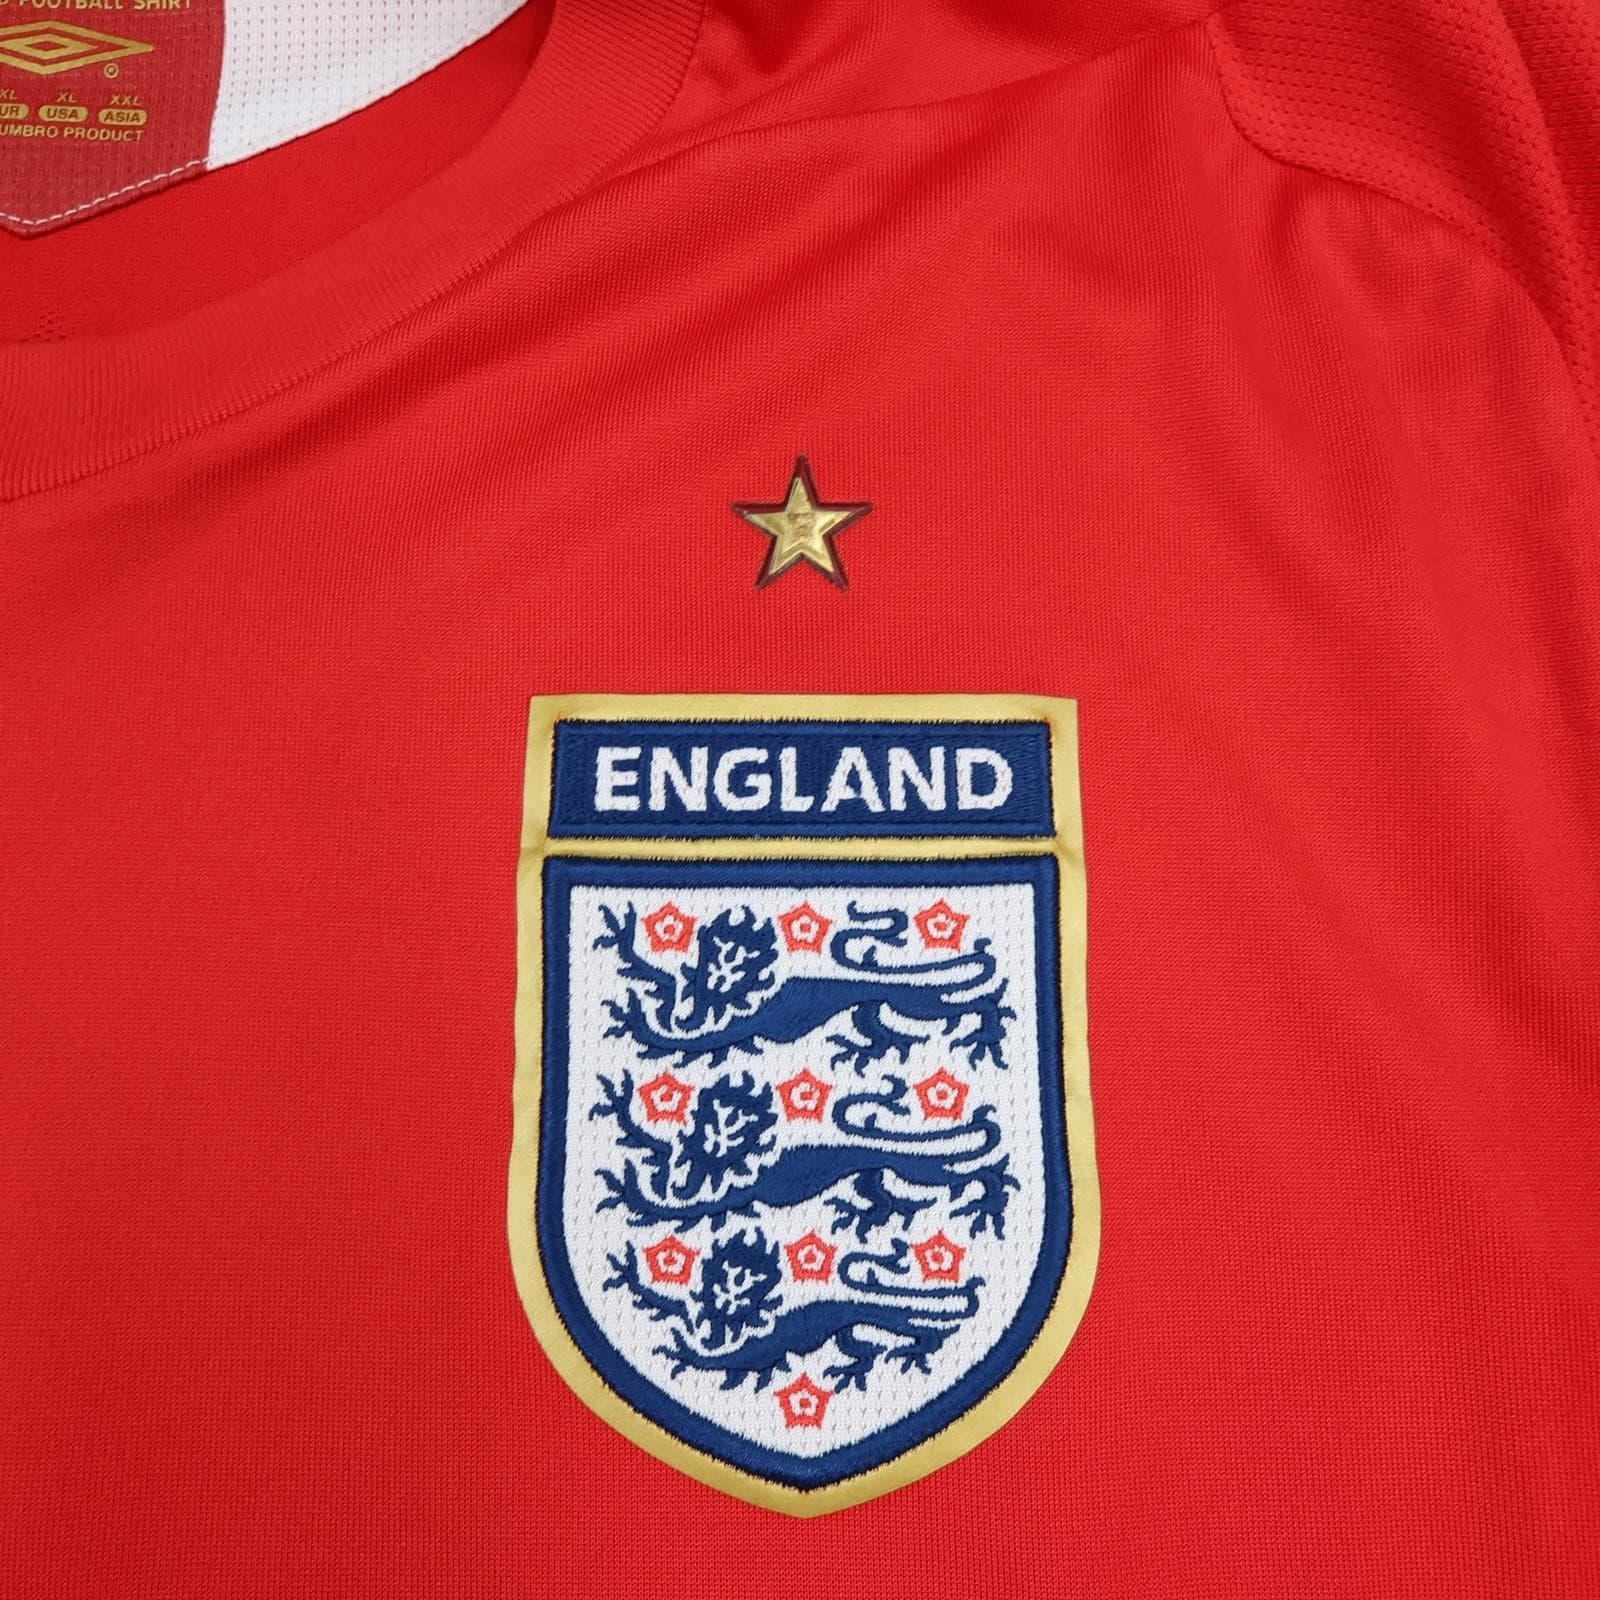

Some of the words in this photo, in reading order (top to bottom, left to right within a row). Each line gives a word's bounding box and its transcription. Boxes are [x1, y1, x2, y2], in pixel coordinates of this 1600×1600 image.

[133, 0, 191, 9] SHIRT
[57, 91, 78, 103] XL
[110, 94, 142, 106] XXL
[0, 105, 20, 117] UR
[46, 107, 79, 119] USA
[103, 110, 141, 123] ASIA
[0, 124, 59, 138] UMBRO
[63, 126, 145, 142] PRODUCT
[594, 746, 1013, 813] ENGLAND
